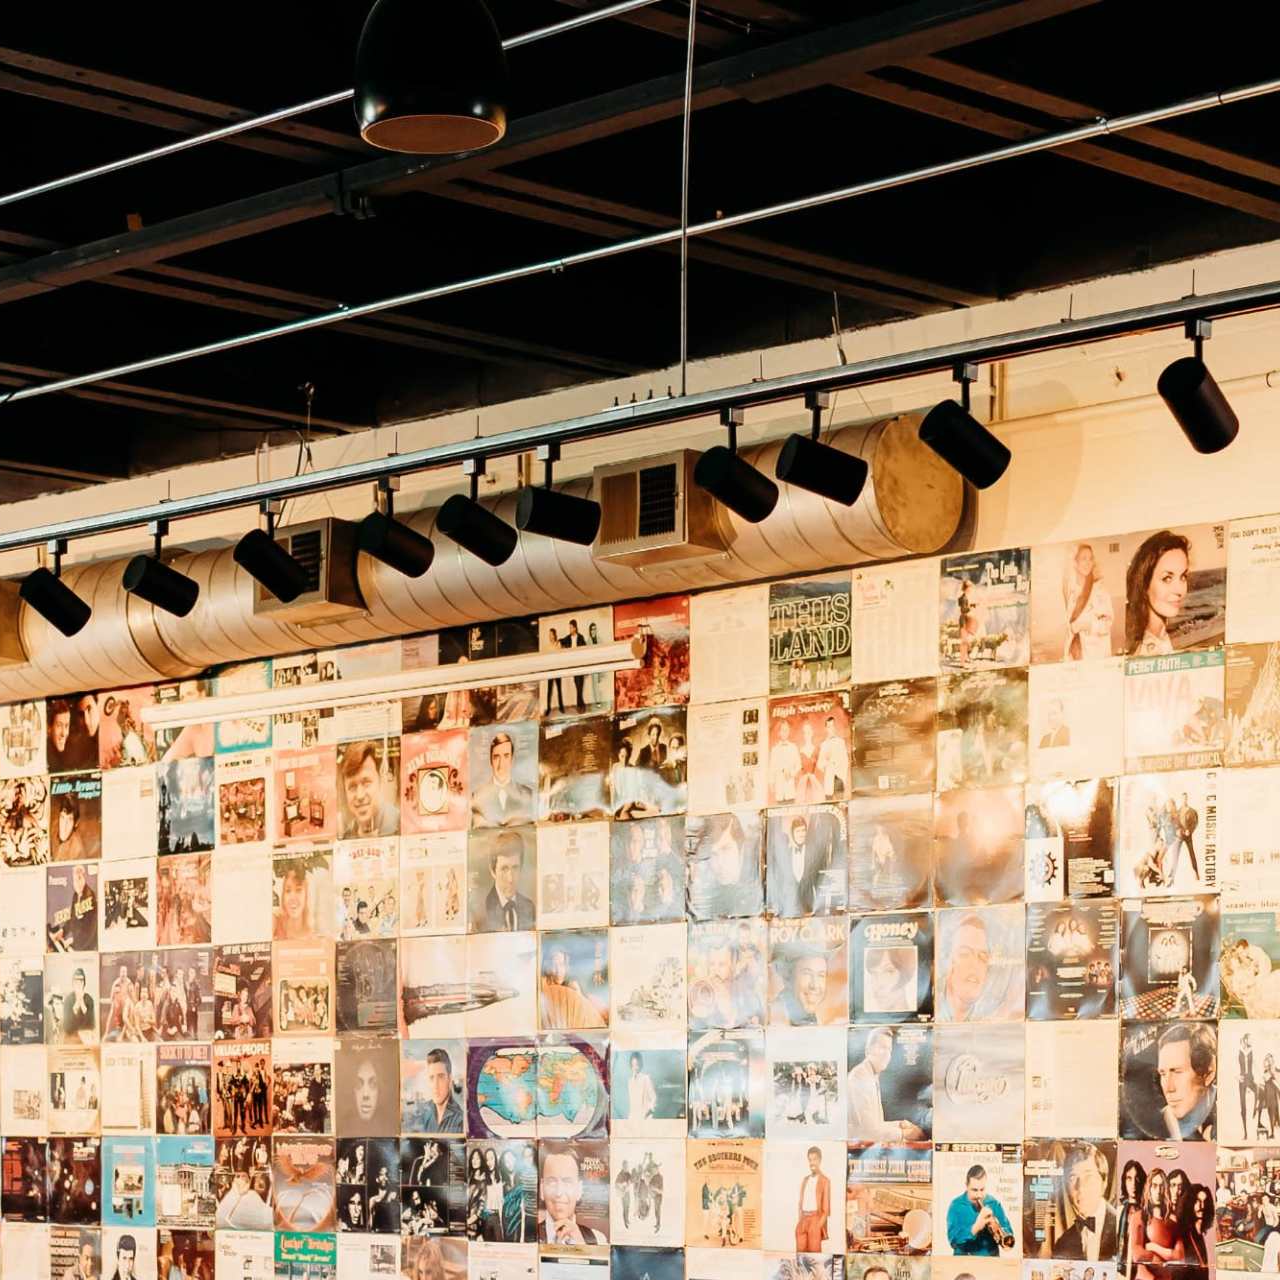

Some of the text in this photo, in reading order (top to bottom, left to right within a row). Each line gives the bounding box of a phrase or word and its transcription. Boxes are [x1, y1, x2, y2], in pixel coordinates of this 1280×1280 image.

[770, 593, 851, 632] THIS
[770, 623, 851, 664] LAND
[772, 705, 795, 718] High
[952, 1143, 997, 1153] STEREO
